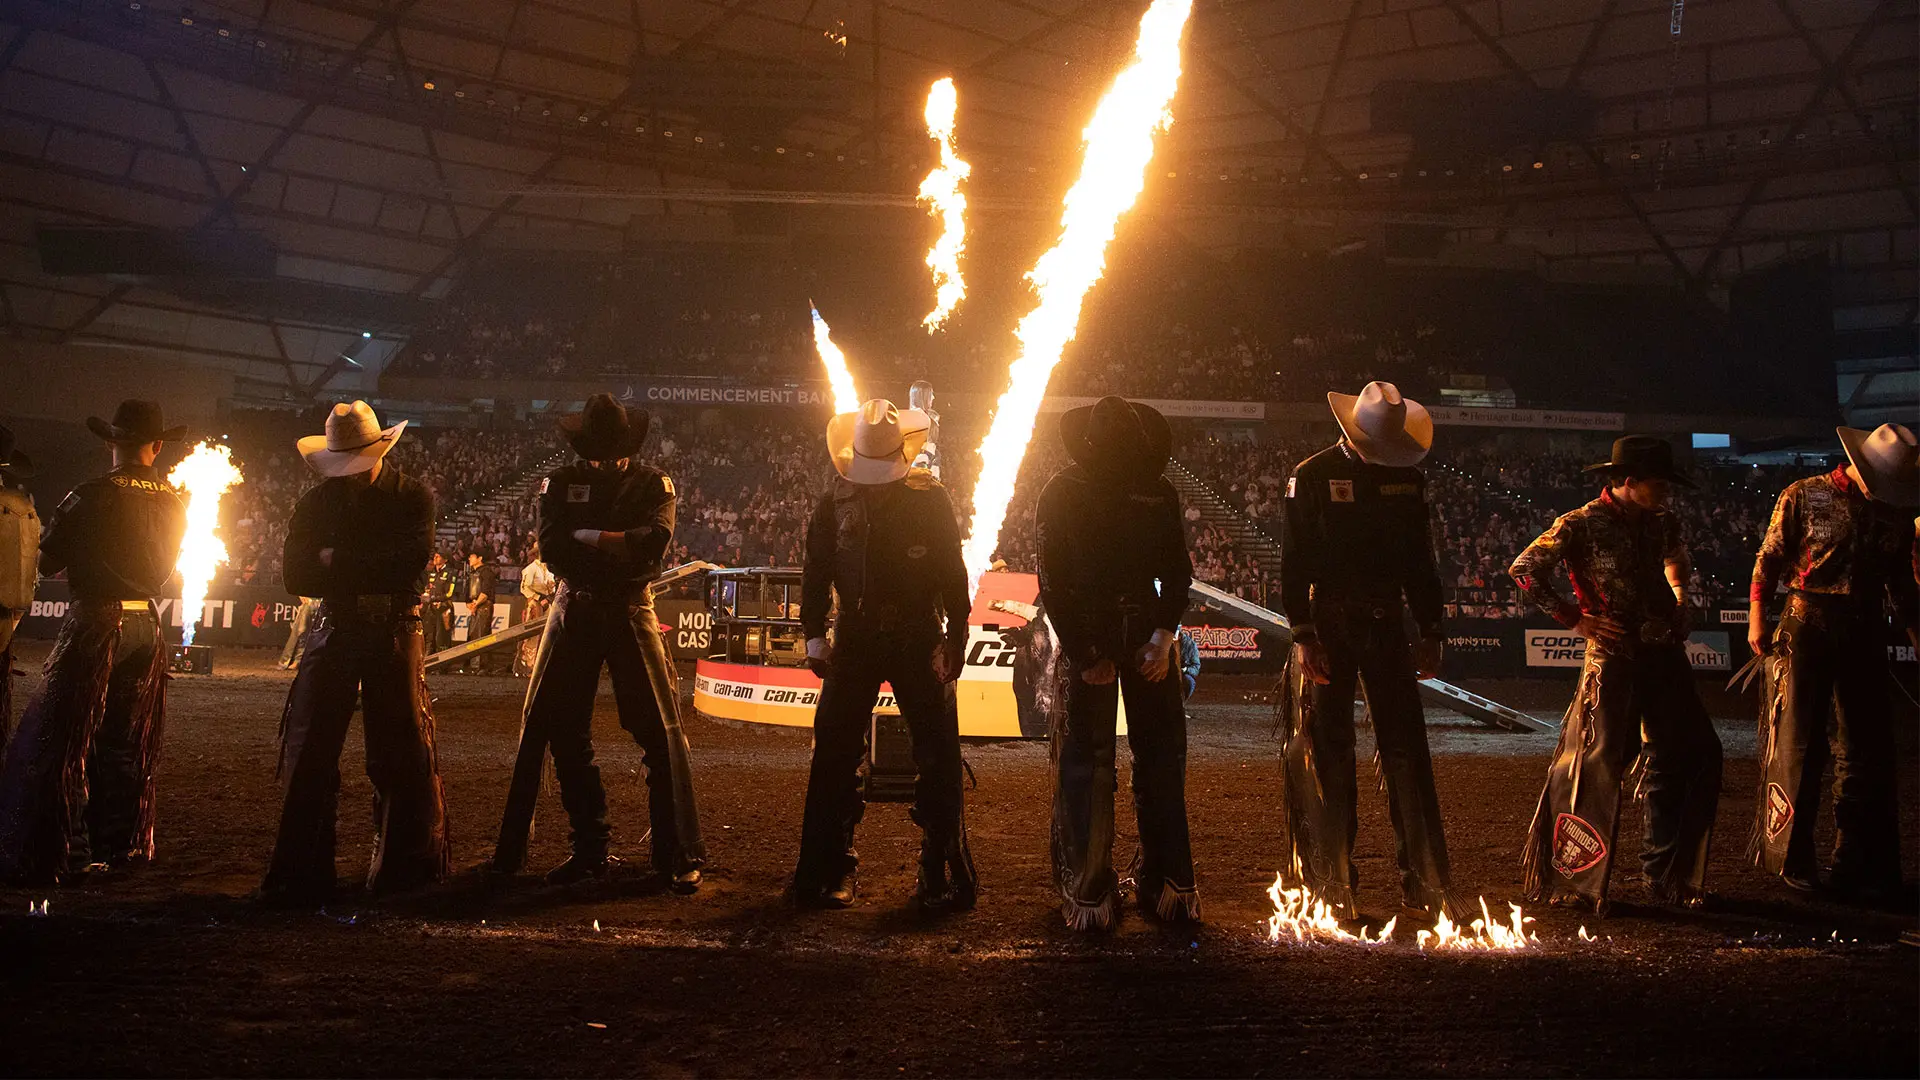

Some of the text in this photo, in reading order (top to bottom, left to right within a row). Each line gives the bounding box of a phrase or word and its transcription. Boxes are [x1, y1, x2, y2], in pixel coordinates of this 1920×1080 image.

[647, 386, 793, 404] COMMENCEMENT
[1470, 411, 1533, 422] Heritage Bank
[1554, 414, 1617, 426] Heritage Bank
[1722, 612, 1747, 620] FLOOR
[1447, 636, 1502, 648] MONSTER
[713, 681, 753, 699] can-am
[1562, 817, 1600, 854] THUNDER
